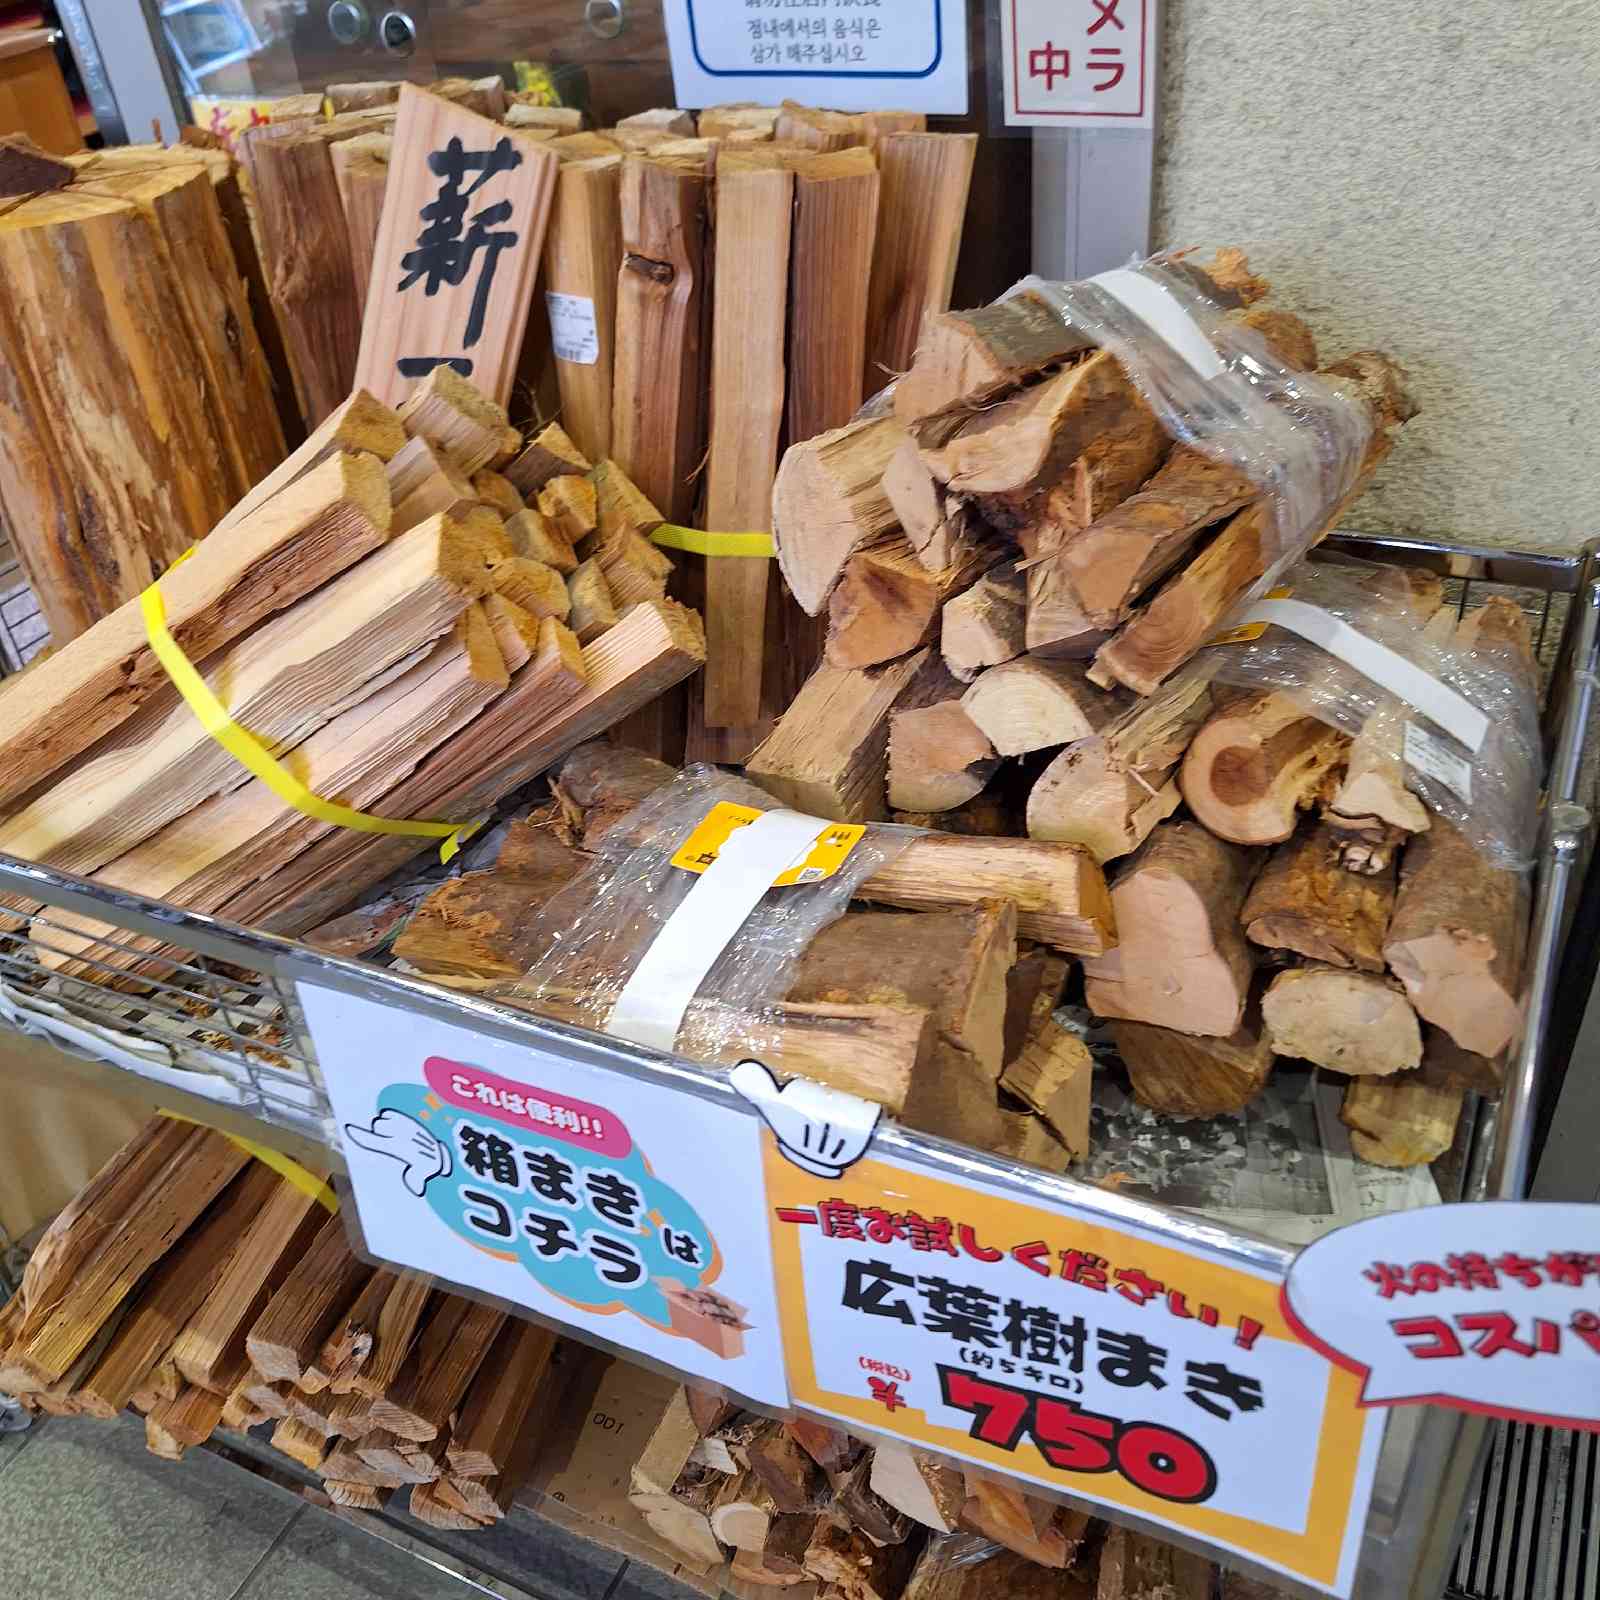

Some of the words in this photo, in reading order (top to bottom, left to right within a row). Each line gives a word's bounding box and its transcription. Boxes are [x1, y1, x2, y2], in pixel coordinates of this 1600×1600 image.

[451, 1074, 605, 1140] これは便利!!
[458, 1124, 642, 1230] 箱まき
[462, 1190, 642, 1285] コチラ
[841, 1257, 1266, 1422] 広葉樹まき
[935, 1362, 1218, 1505] 750
